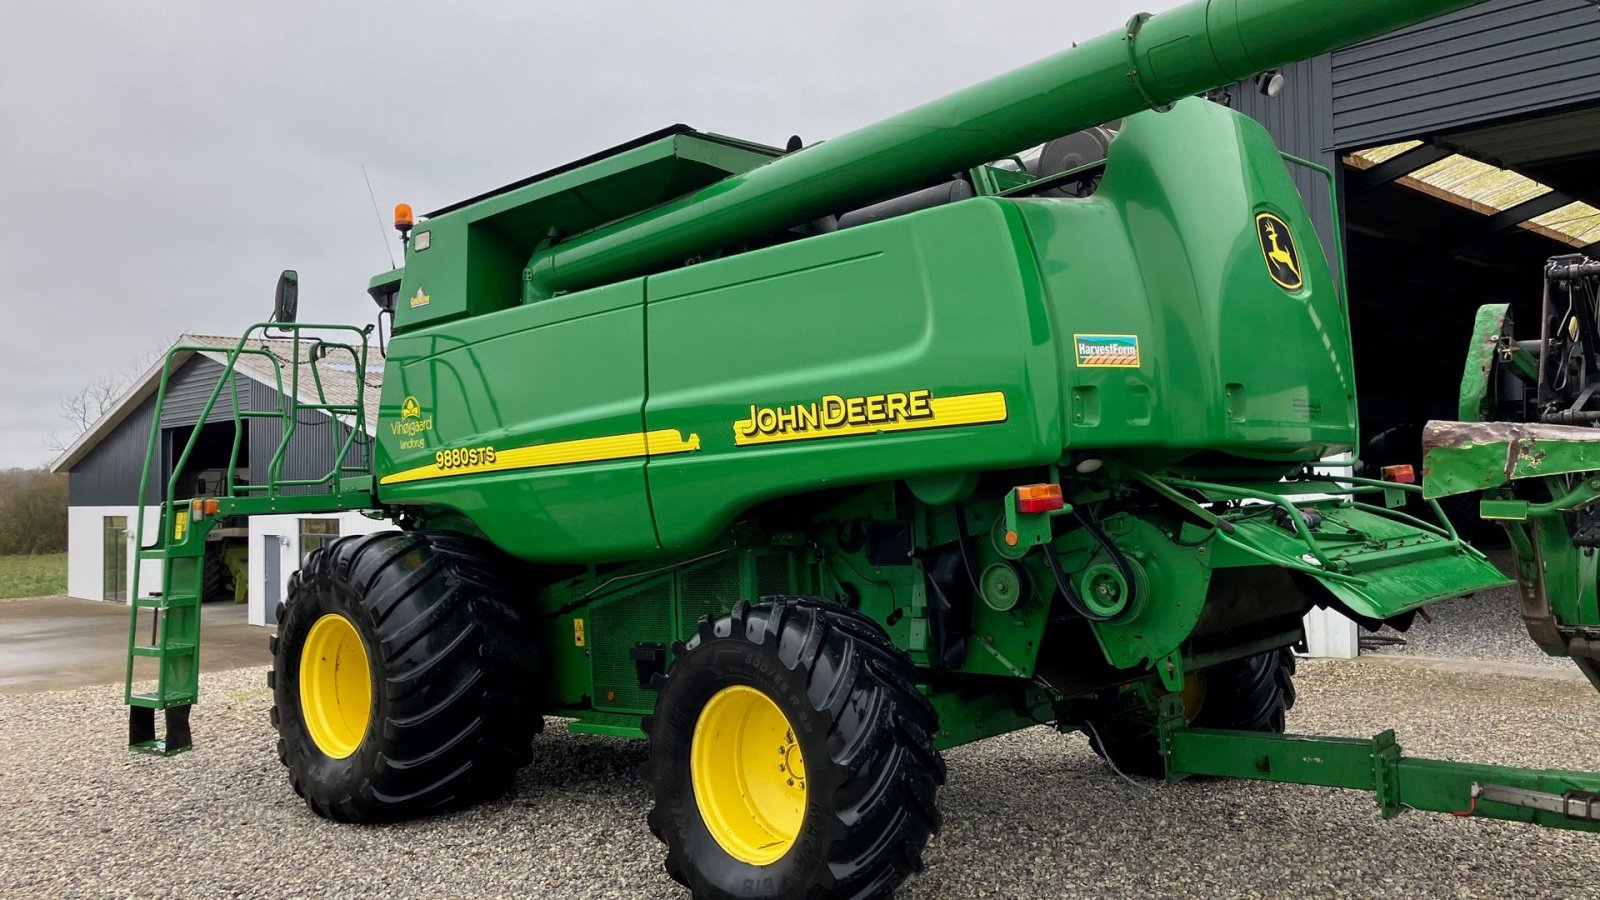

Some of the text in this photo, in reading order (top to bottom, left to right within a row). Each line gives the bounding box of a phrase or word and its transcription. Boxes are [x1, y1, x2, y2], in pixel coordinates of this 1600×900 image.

[1078, 343, 1136, 355] HarvestForm
[741, 389, 932, 436] JOHN DEERE
[400, 438, 425, 449] landbrug
[436, 446, 496, 468] 9880STS
